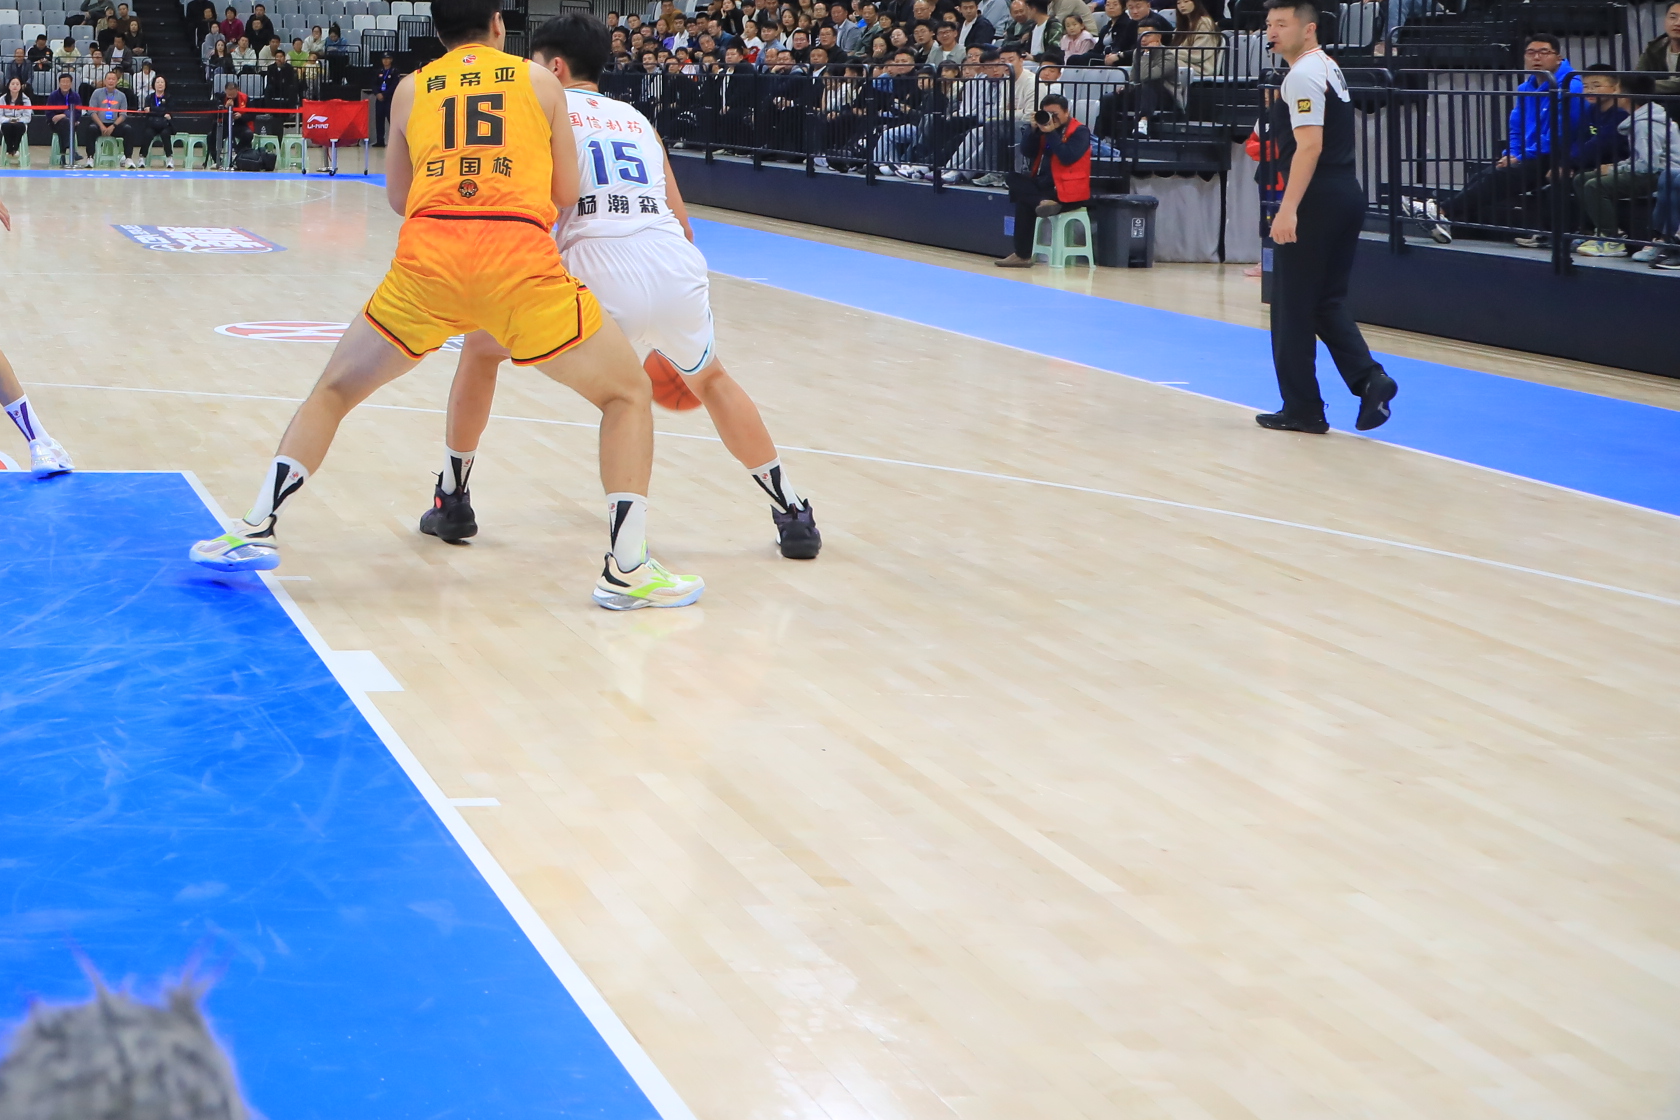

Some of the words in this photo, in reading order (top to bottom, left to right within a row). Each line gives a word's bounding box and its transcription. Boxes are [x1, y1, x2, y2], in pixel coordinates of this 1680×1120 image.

[426, 66, 516, 94] 肯帝亚
[438, 91, 507, 152] 16
[426, 156, 513, 179] 马国栋
[586, 137, 652, 188] 15
[577, 192, 661, 218] 杨瀚森
